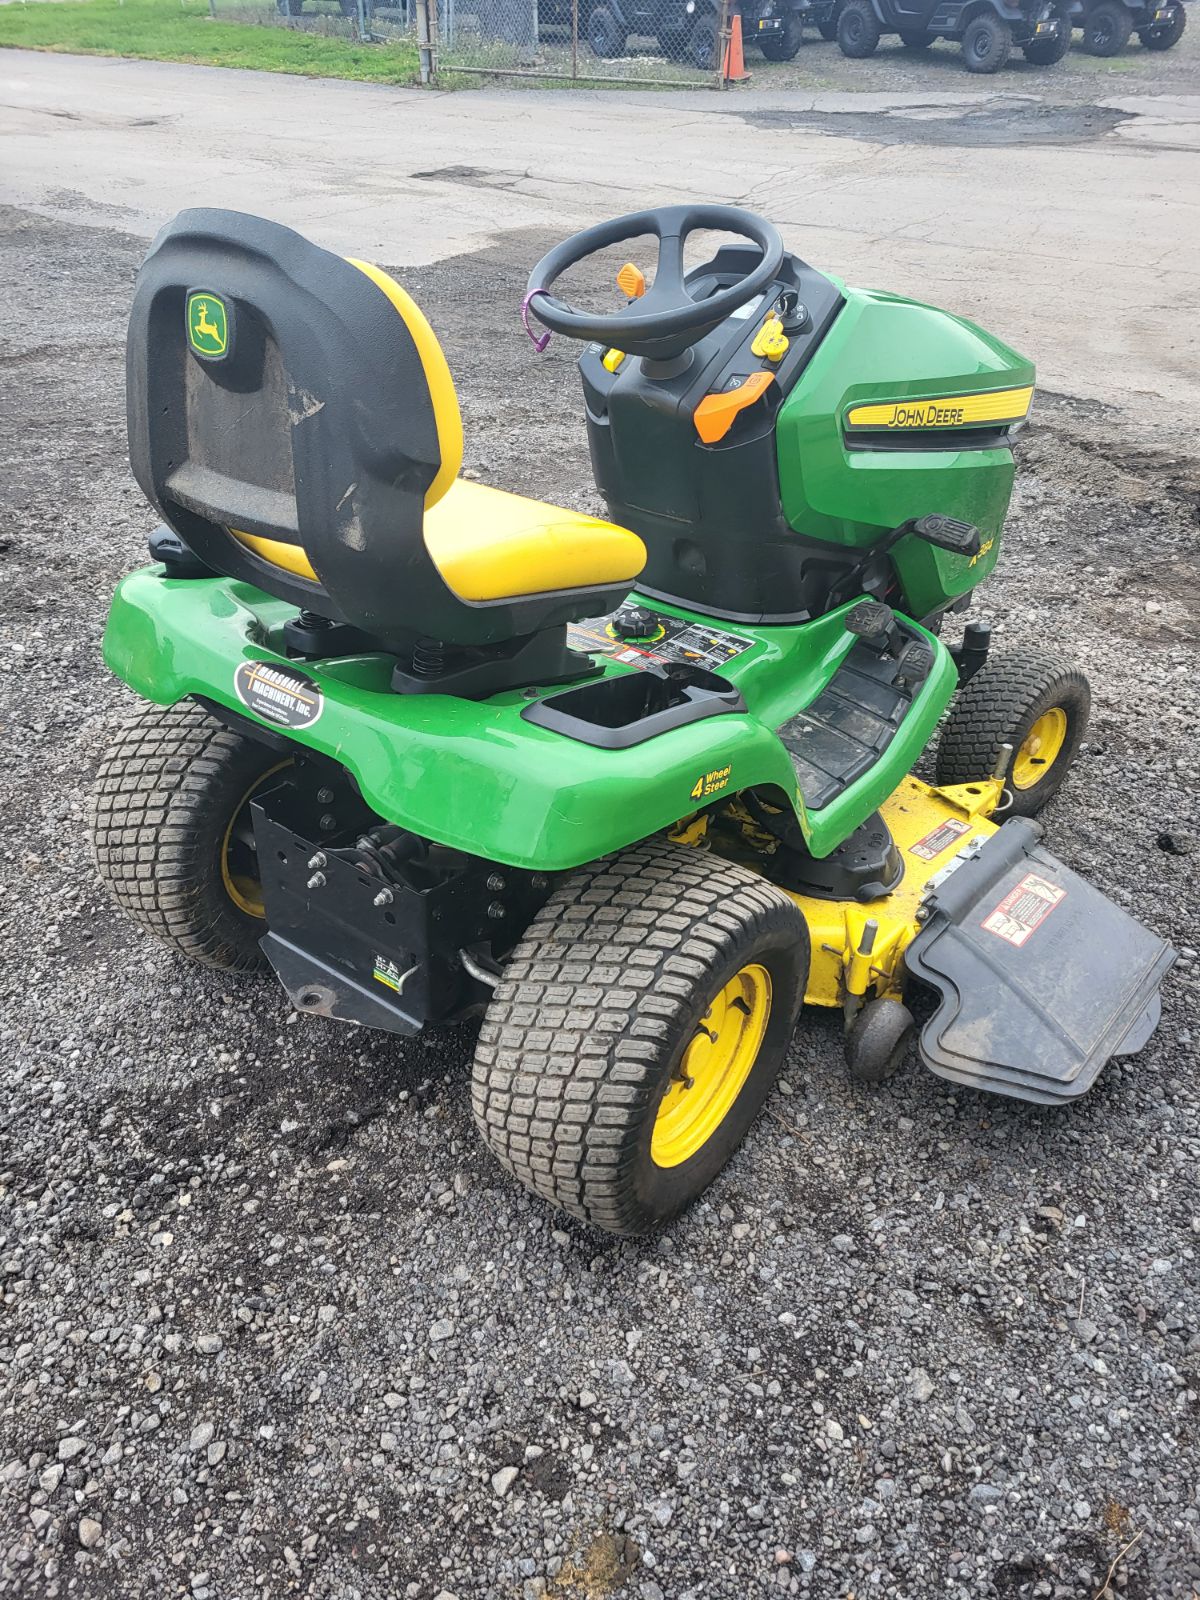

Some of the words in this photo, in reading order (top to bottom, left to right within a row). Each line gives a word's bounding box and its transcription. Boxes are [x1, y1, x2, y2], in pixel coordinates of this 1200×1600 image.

[889, 406, 925, 425] JOHN
[926, 406, 964, 424] DEERE
[257, 666, 304, 693] MARSHALL
[252, 680, 296, 710] MACHINERY,
[296, 700, 311, 718] Inc.
[691, 777, 704, 798] 4
[706, 764, 732, 784] Wheel
[704, 778, 729, 796] Steer
